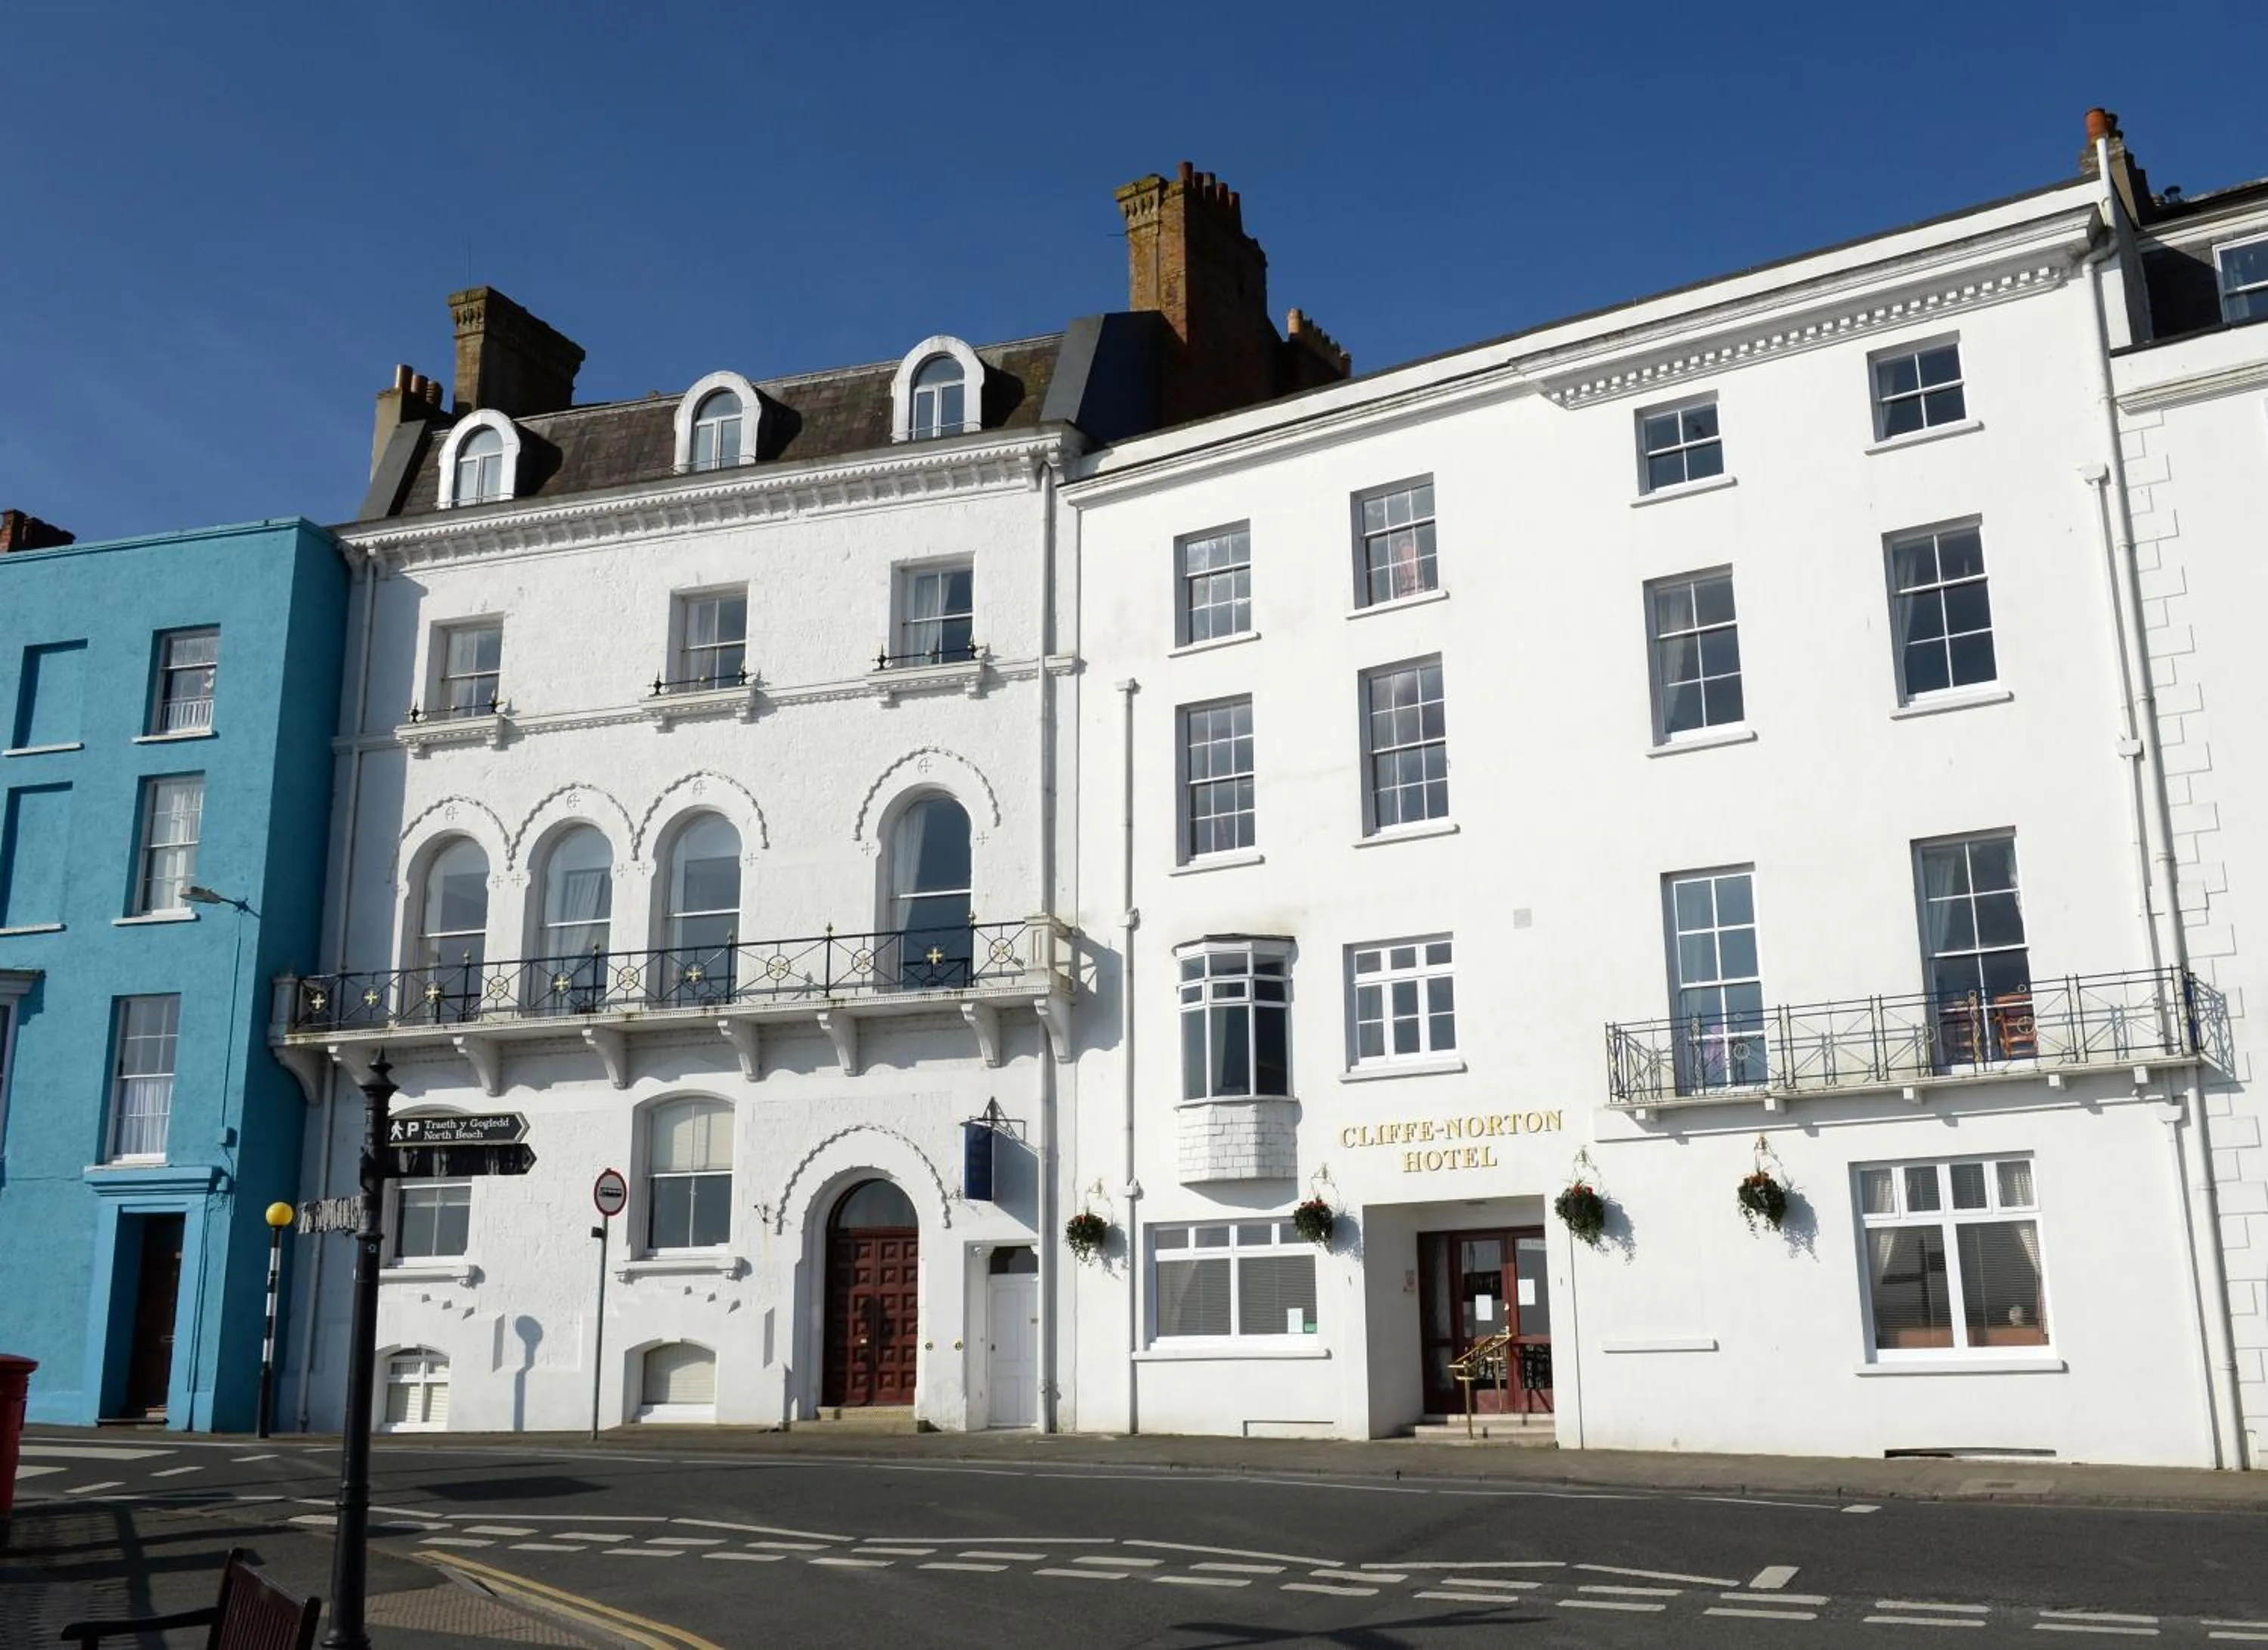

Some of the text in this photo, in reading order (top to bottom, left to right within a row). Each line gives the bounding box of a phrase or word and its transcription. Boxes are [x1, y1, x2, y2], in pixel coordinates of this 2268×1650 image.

[407, 1121, 420, 1137] P
[460, 1121, 467, 1130] y
[1340, 1109, 1563, 1148] CLIFFE-NORTON
[423, 1130, 483, 1140] North Beach
[1402, 1146, 1498, 1173] HOTEL
